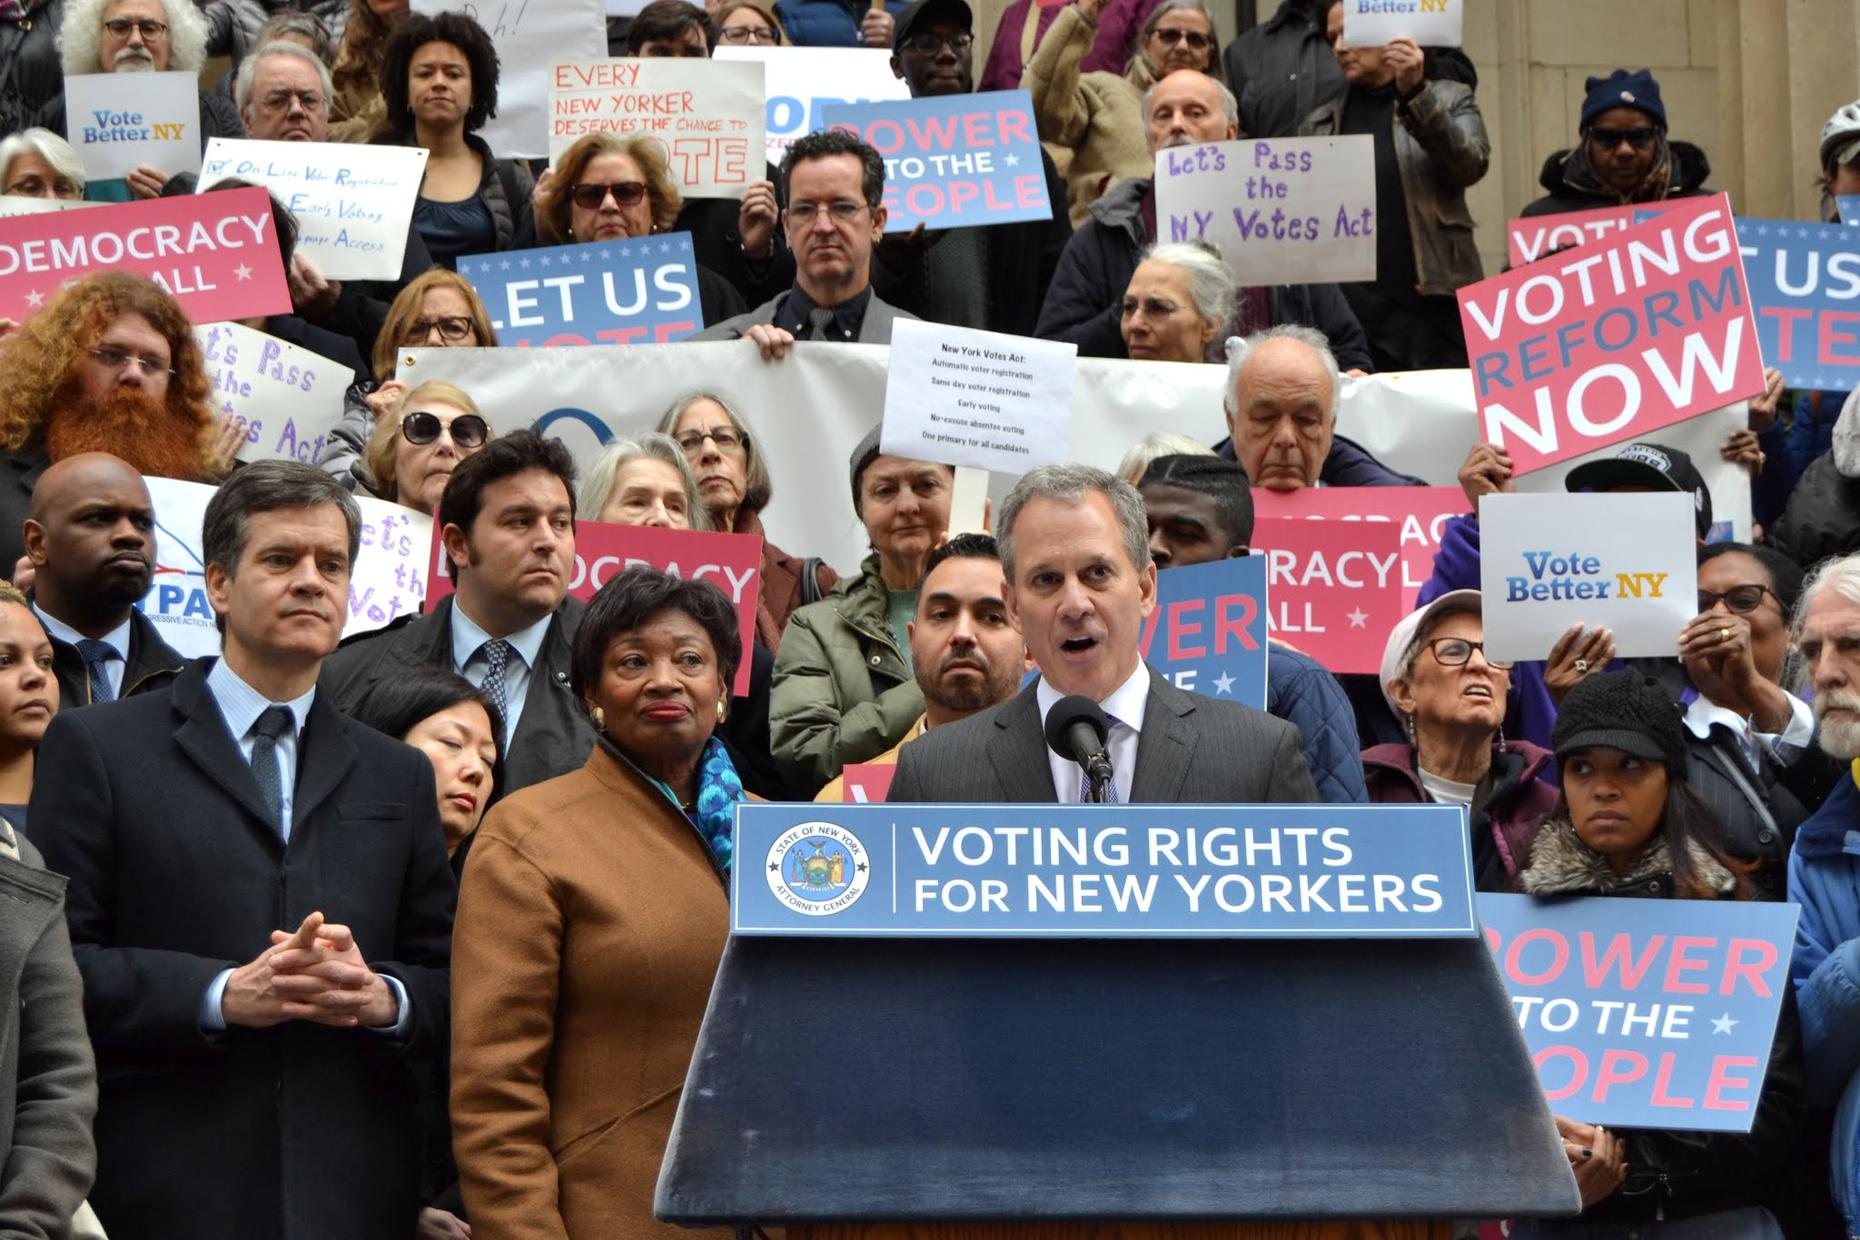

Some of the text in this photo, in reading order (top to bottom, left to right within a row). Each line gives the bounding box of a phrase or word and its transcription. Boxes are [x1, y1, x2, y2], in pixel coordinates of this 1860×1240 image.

[1357, 0, 1448, 13] Better NY
[555, 64, 641, 88] EVERY
[555, 91, 695, 115] NEW YORKER
[82, 123, 186, 144] Better NY
[92, 109, 143, 129] Vote
[554, 119, 638, 136] DESERVES
[642, 117, 671, 132] THE
[729, 119, 748, 131] TO
[655, 137, 748, 186] TE
[884, 151, 995, 180] TO THE
[1168, 141, 1313, 176] Let's Pass
[882, 175, 1047, 218] EOPLE
[1245, 175, 1288, 199] the
[288, 193, 385, 223] Early Voting
[1170, 203, 1373, 243] NY Votes Act
[335, 228, 385, 251] Access
[1465, 210, 1732, 341] VOTING
[1774, 248, 1860, 300] US
[602, 263, 693, 317] US
[1475, 266, 1742, 397] REFORM
[1760, 306, 1860, 366] TE
[206, 327, 316, 392] t's Pass
[941, 343, 1027, 363] New York Votes Act:
[211, 369, 252, 397] the
[932, 358, 1033, 381] Automatic voter registration
[931, 377, 1031, 399] Same day voter registration
[1483, 316, 1745, 456] NOW
[958, 399, 1001, 413] Early voting
[930, 413, 1025, 435] No-excuse absentee voting
[275, 417, 325, 467] Act
[922, 431, 1030, 455] One primary for all candidates
[361, 515, 412, 557] et's
[395, 563, 425, 597] th
[1522, 550, 1601, 580] Vote
[1506, 572, 1668, 602] Better NY
[1268, 602, 1326, 633] LL
[776, 826, 861, 856] STATE OF NEW YORK
[911, 826, 1353, 867] VOTING RIGHTS
[776, 885, 861, 912] ATTORNEY GENERAL
[914, 873, 1444, 913] FOR NEW YORKERS
[1511, 995, 1695, 1039] TO THE
[1534, 1045, 1758, 1111] OPLE
